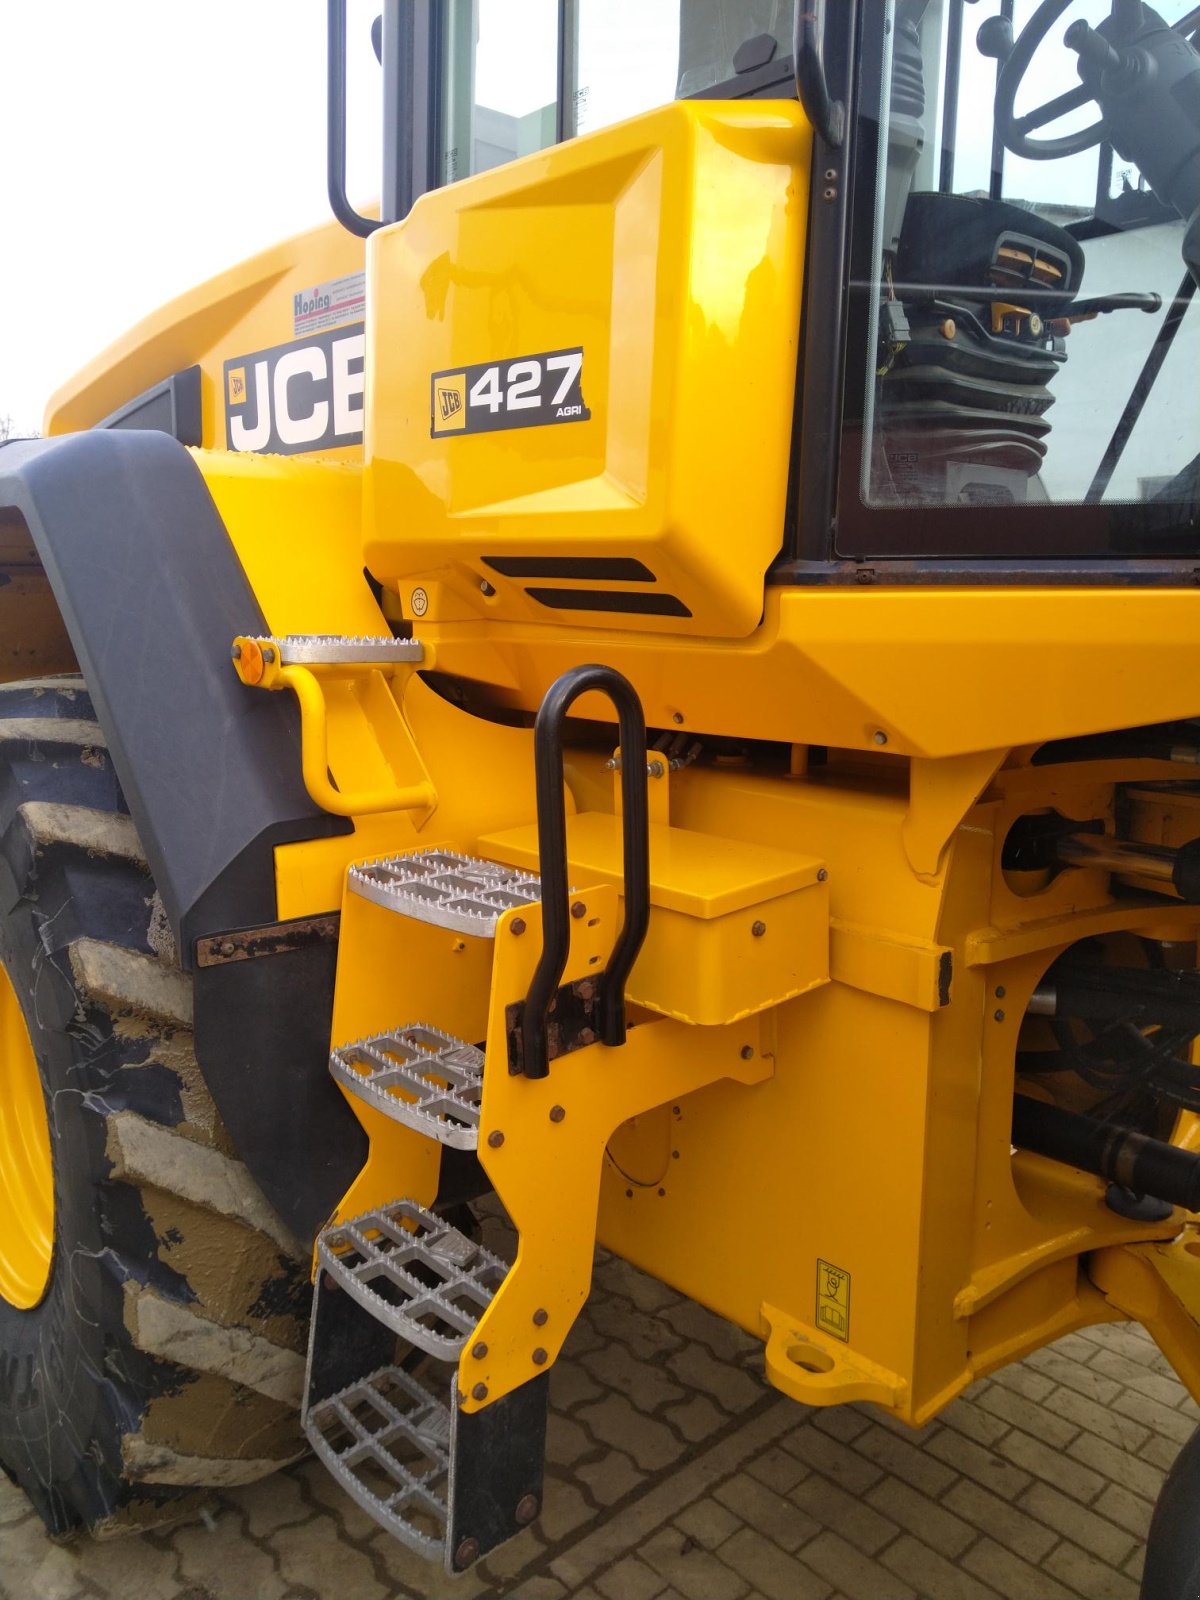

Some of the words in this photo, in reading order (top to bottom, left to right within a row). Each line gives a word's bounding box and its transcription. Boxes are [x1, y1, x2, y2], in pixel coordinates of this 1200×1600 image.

[294, 288, 330, 316] Hoping
[469, 352, 583, 413] 427
[441, 391, 460, 416] JCB
[555, 404, 582, 417] AGRI
